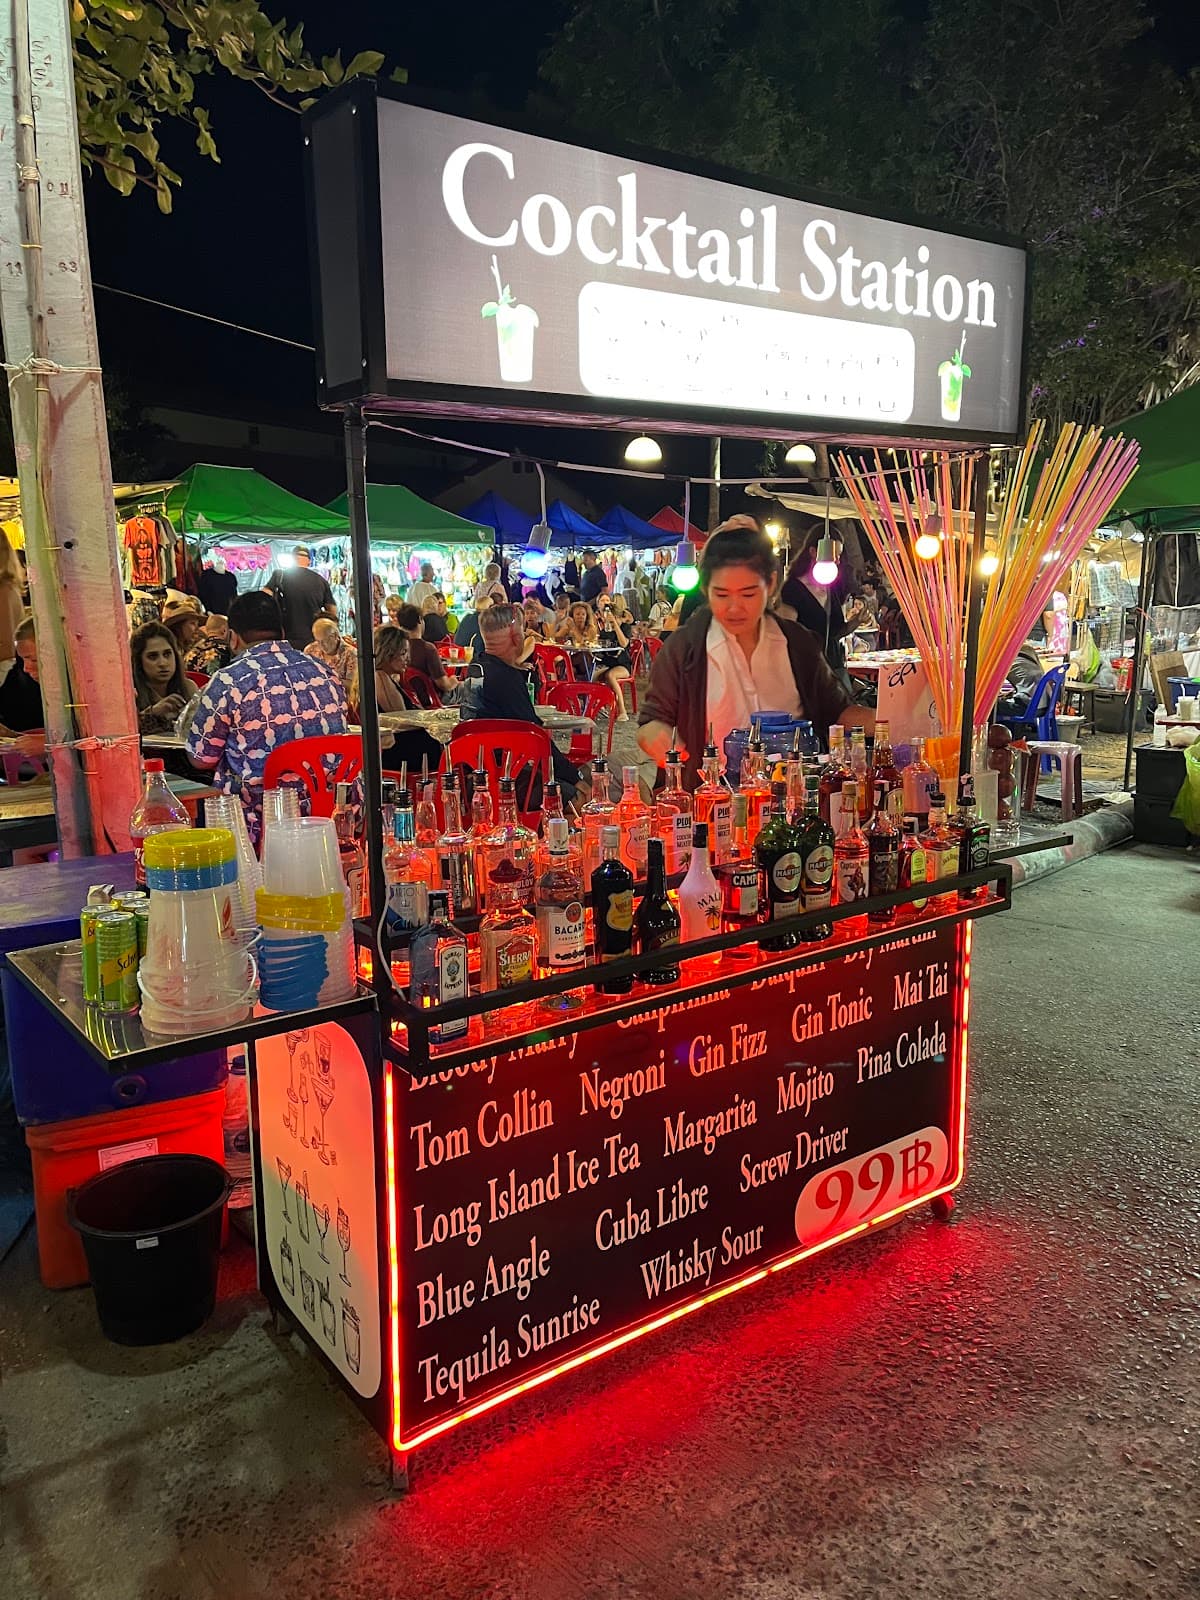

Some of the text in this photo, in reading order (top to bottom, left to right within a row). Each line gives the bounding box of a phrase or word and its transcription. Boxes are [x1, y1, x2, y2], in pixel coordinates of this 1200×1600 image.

[442, 142, 997, 328] Cocktail Station
[791, 987, 873, 1043] Gin Tonic
[893, 962, 948, 1011] Mai Tai
[579, 1050, 666, 1120] Negroni
[689, 1023, 768, 1078] Gin Fizz
[856, 1019, 947, 1084] Pina Colada
[663, 1095, 758, 1157] Margarita
[776, 1065, 834, 1117] Mojito
[410, 1087, 554, 1172] Tom Collin
[739, 1124, 849, 1193] Screw Driver
[413, 1132, 641, 1252] Long Island Ice Tea
[594, 1177, 709, 1252] Cuba Libre
[416, 1237, 551, 1329] Blue Angle
[639, 1225, 764, 1301] Whisky Sour
[417, 1294, 601, 1404] Tequila Sunrise
